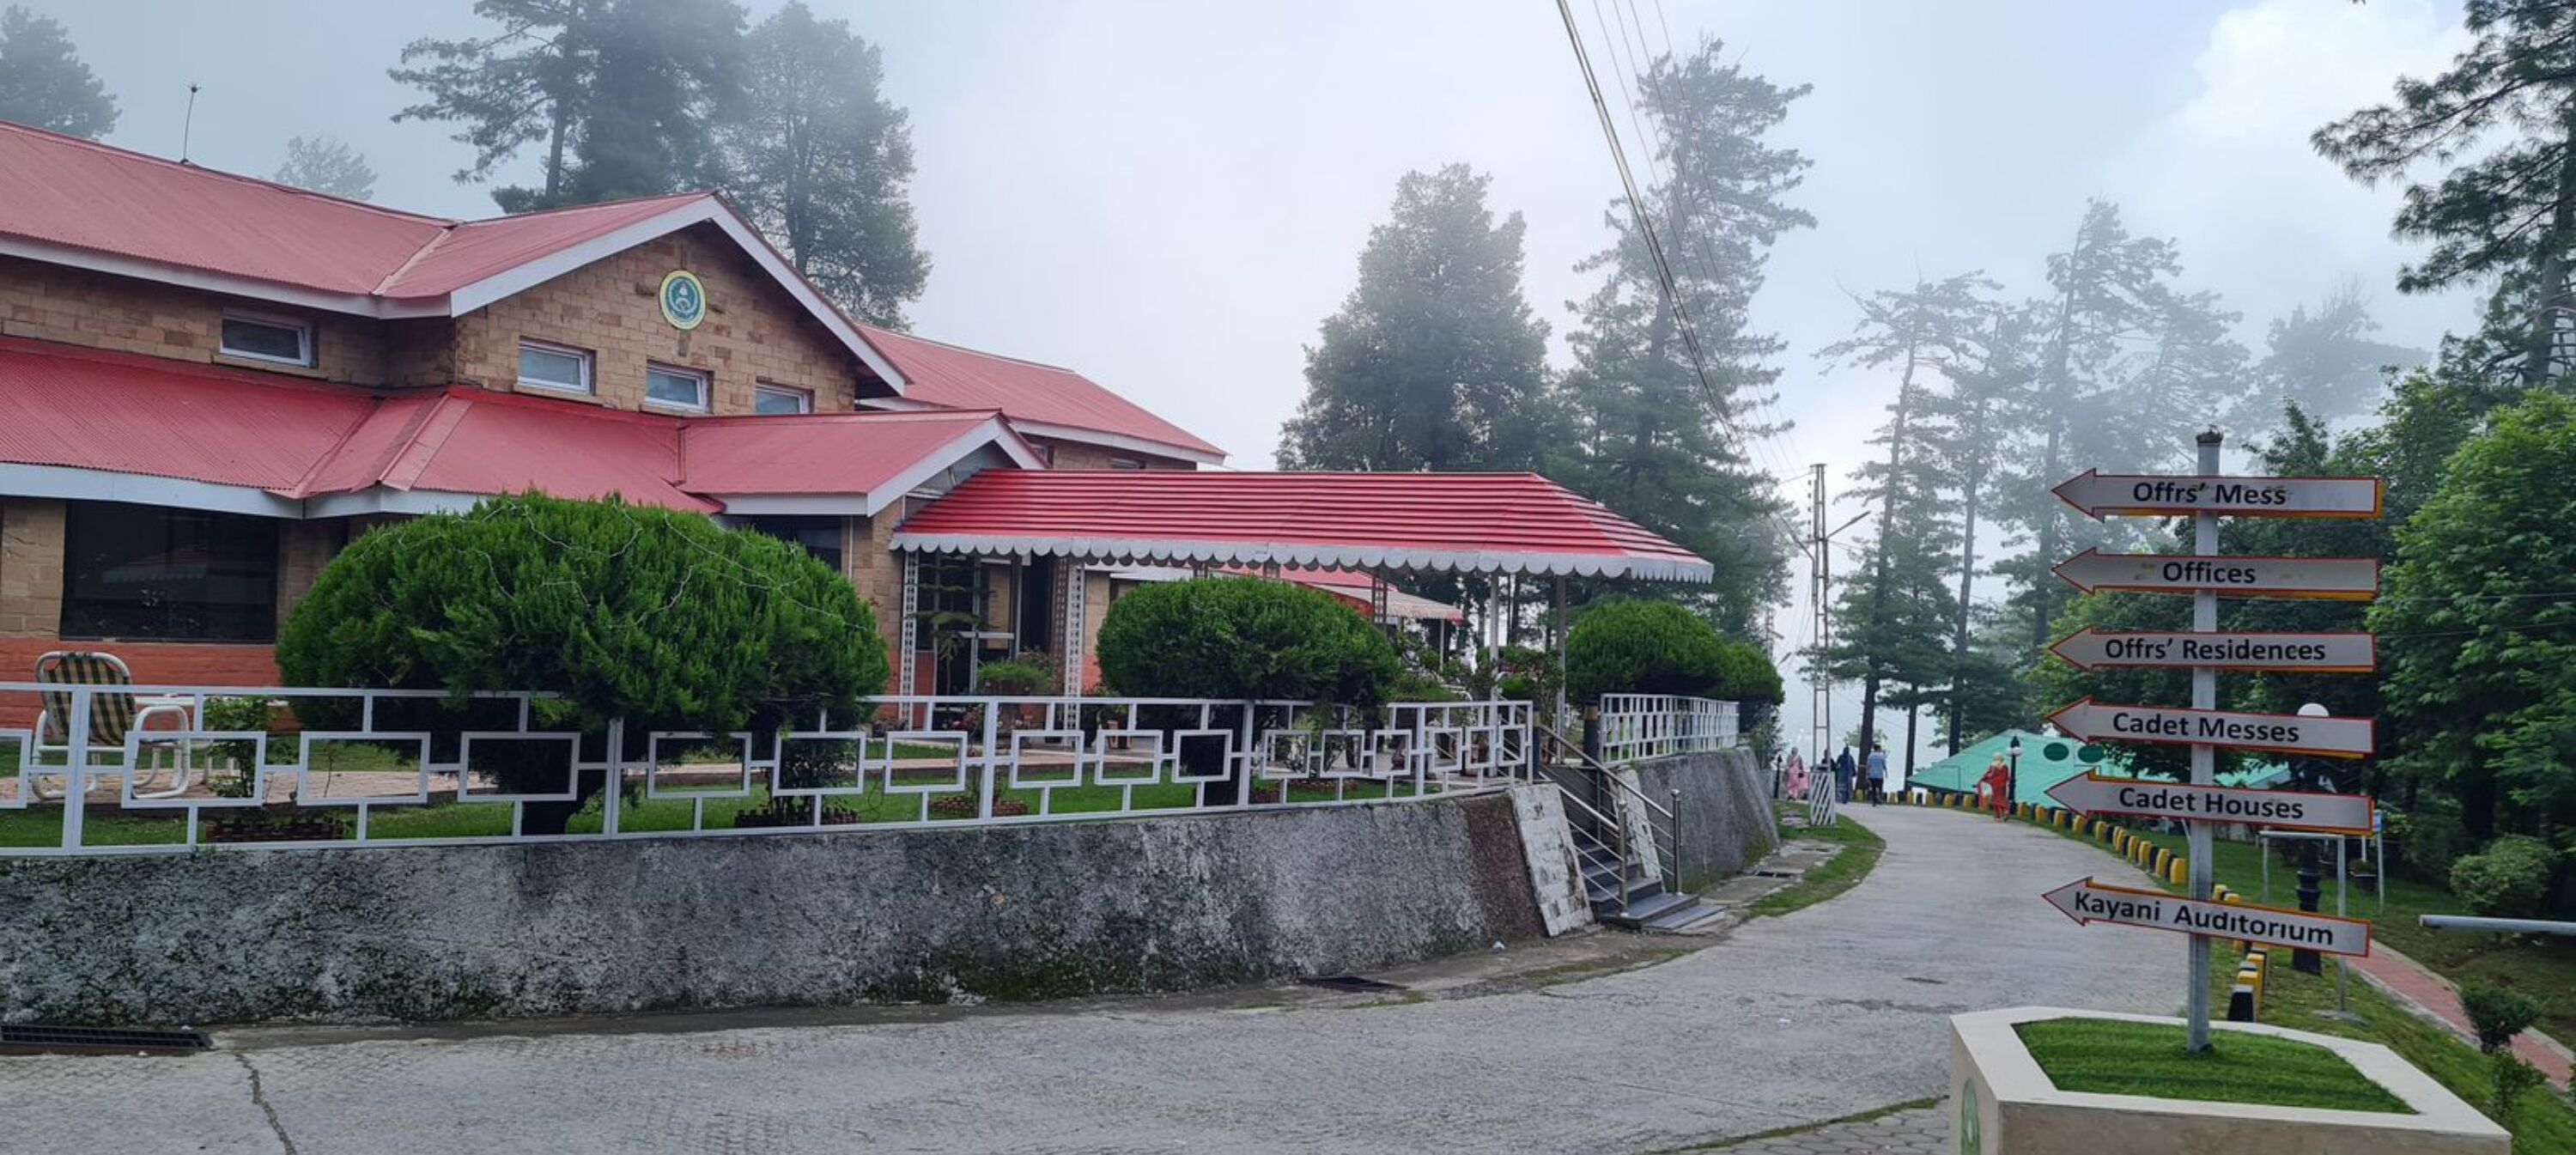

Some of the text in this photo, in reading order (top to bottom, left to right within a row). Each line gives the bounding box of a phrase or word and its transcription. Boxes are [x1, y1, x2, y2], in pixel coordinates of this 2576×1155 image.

[2133, 482, 2287, 505] Offrs' Mess
[2162, 562, 2257, 584] Offices
[2105, 638, 2326, 660] Offrs' Residences
[2113, 712, 2300, 743] Cadet Messes
[2119, 787, 2304, 819] Cadet Houses
[2075, 891, 2334, 945] Kayani Auditorium
